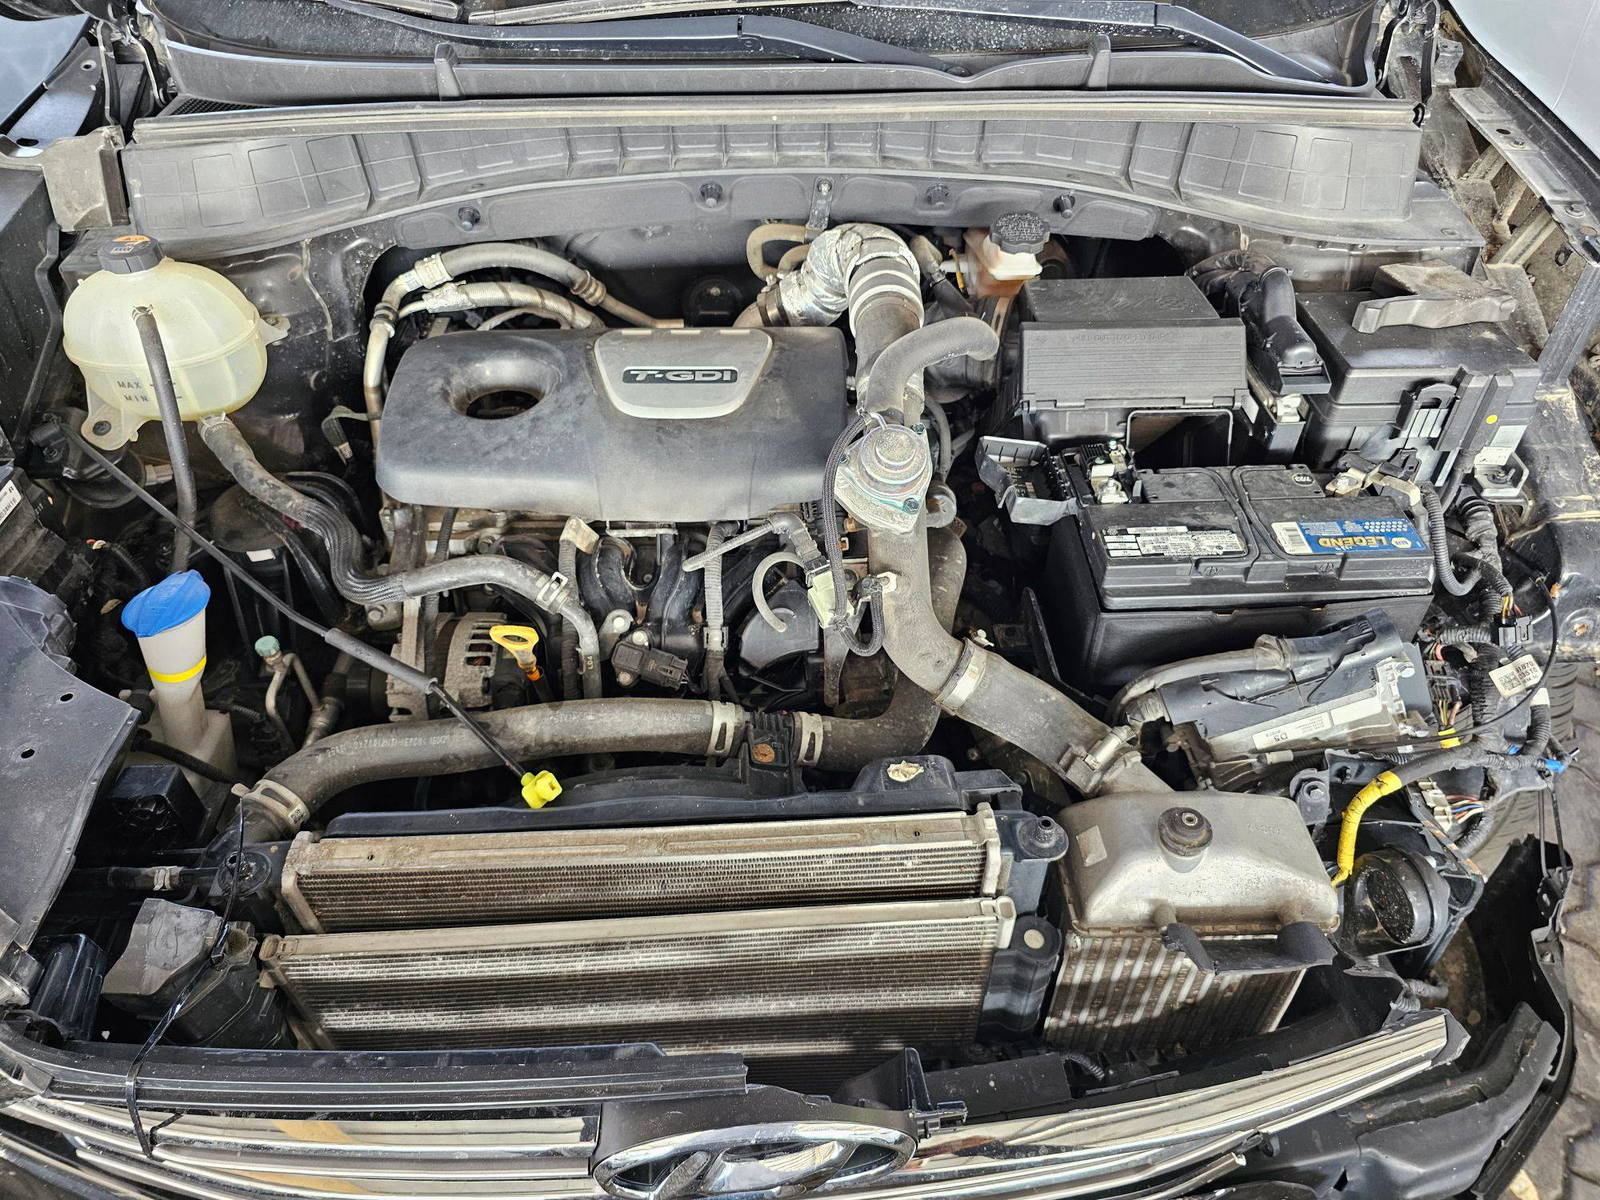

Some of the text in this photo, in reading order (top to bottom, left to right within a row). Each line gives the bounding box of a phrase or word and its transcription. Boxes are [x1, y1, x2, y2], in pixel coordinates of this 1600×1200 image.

[116, 380, 142, 389] MAX
[123, 394, 149, 402] MIN
[1318, 535, 1389, 547] LEGEND
